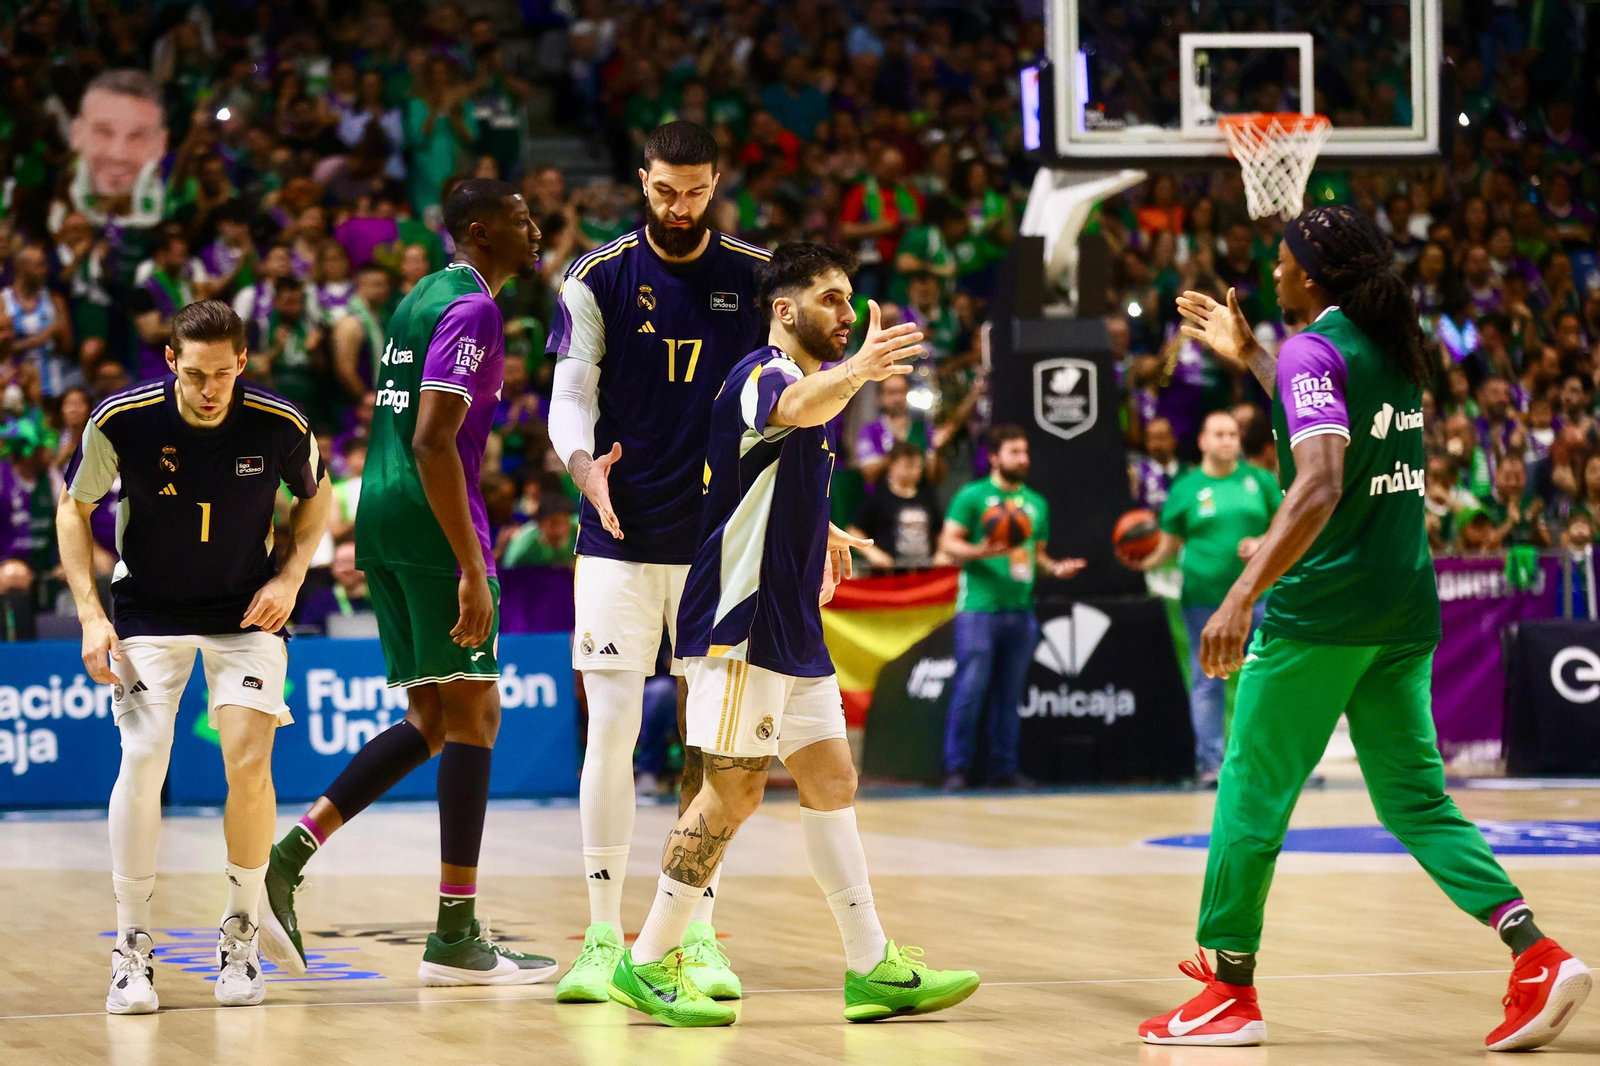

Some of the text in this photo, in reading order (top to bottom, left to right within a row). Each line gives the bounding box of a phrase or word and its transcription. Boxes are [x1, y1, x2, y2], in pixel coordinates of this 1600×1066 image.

[662, 339, 702, 382] 17
[1293, 391, 1336, 409] laga
[196, 502, 211, 542] 1
